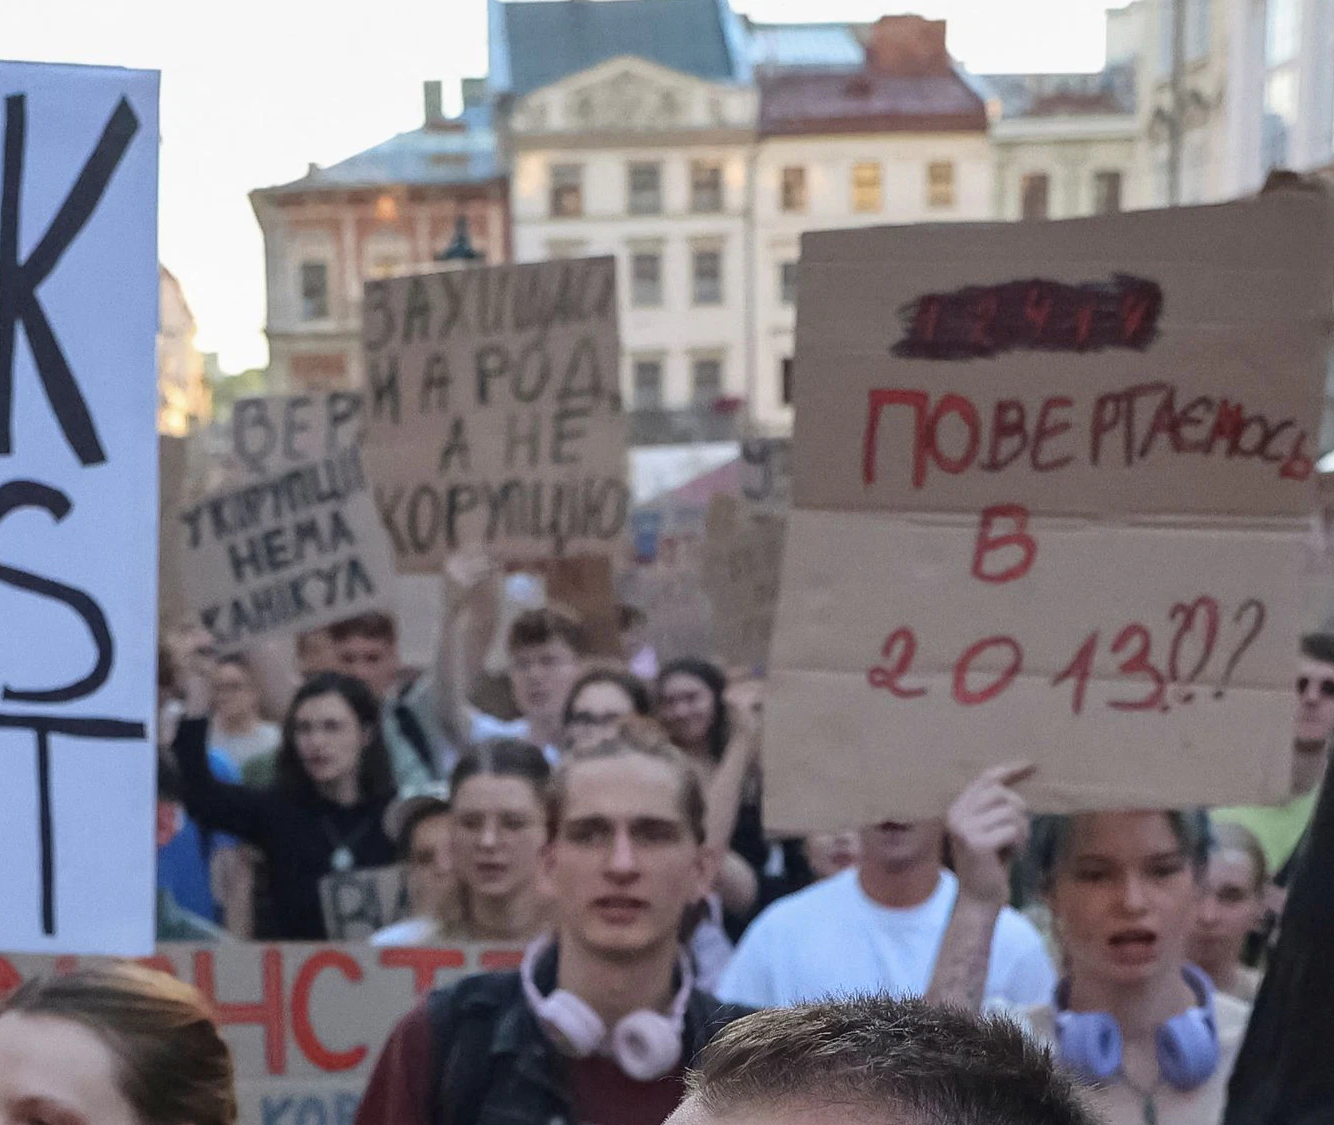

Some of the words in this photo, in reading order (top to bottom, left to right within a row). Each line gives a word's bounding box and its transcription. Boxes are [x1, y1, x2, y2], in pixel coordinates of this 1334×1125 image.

[437, 417, 471, 474] А
[504, 406, 594, 468] НЕ
[228, 511, 356, 582] НЕМА
[970, 503, 1038, 583] В
